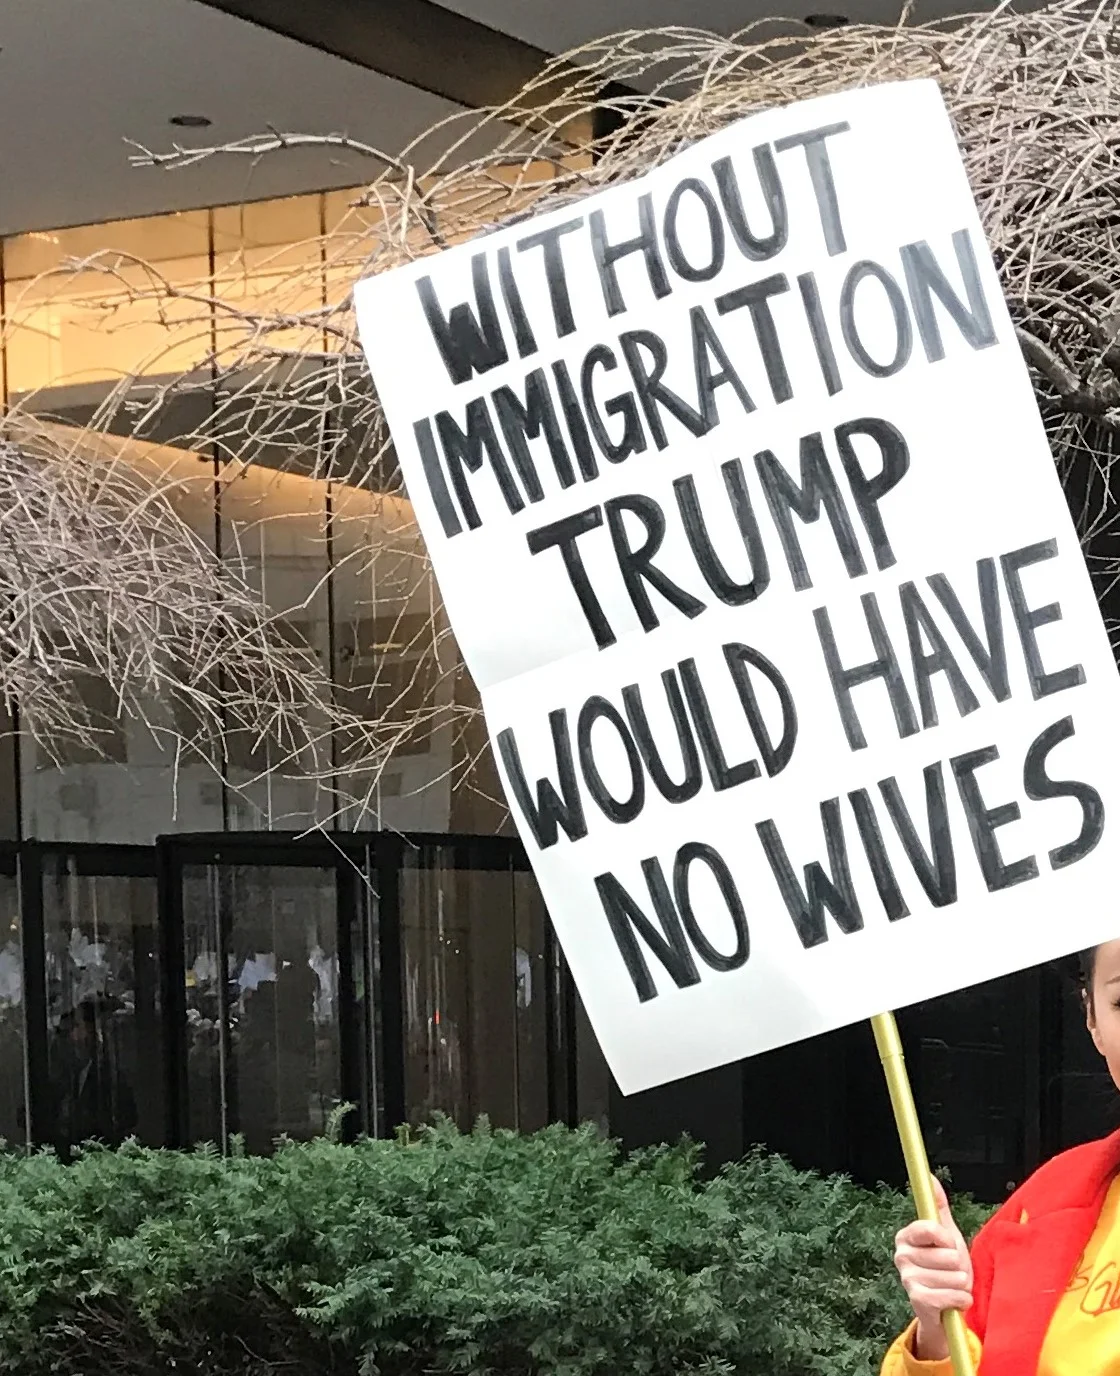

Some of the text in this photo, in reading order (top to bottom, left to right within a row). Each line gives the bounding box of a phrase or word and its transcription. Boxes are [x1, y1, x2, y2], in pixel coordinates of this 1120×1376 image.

[412, 228, 1000, 540] IMMIGRATION
[414, 121, 850, 386] WITHOUT
[525, 416, 912, 652] TRUMP
[495, 537, 1088, 852] WOULD HAVE
[593, 713, 1106, 1004] NO WIVES
